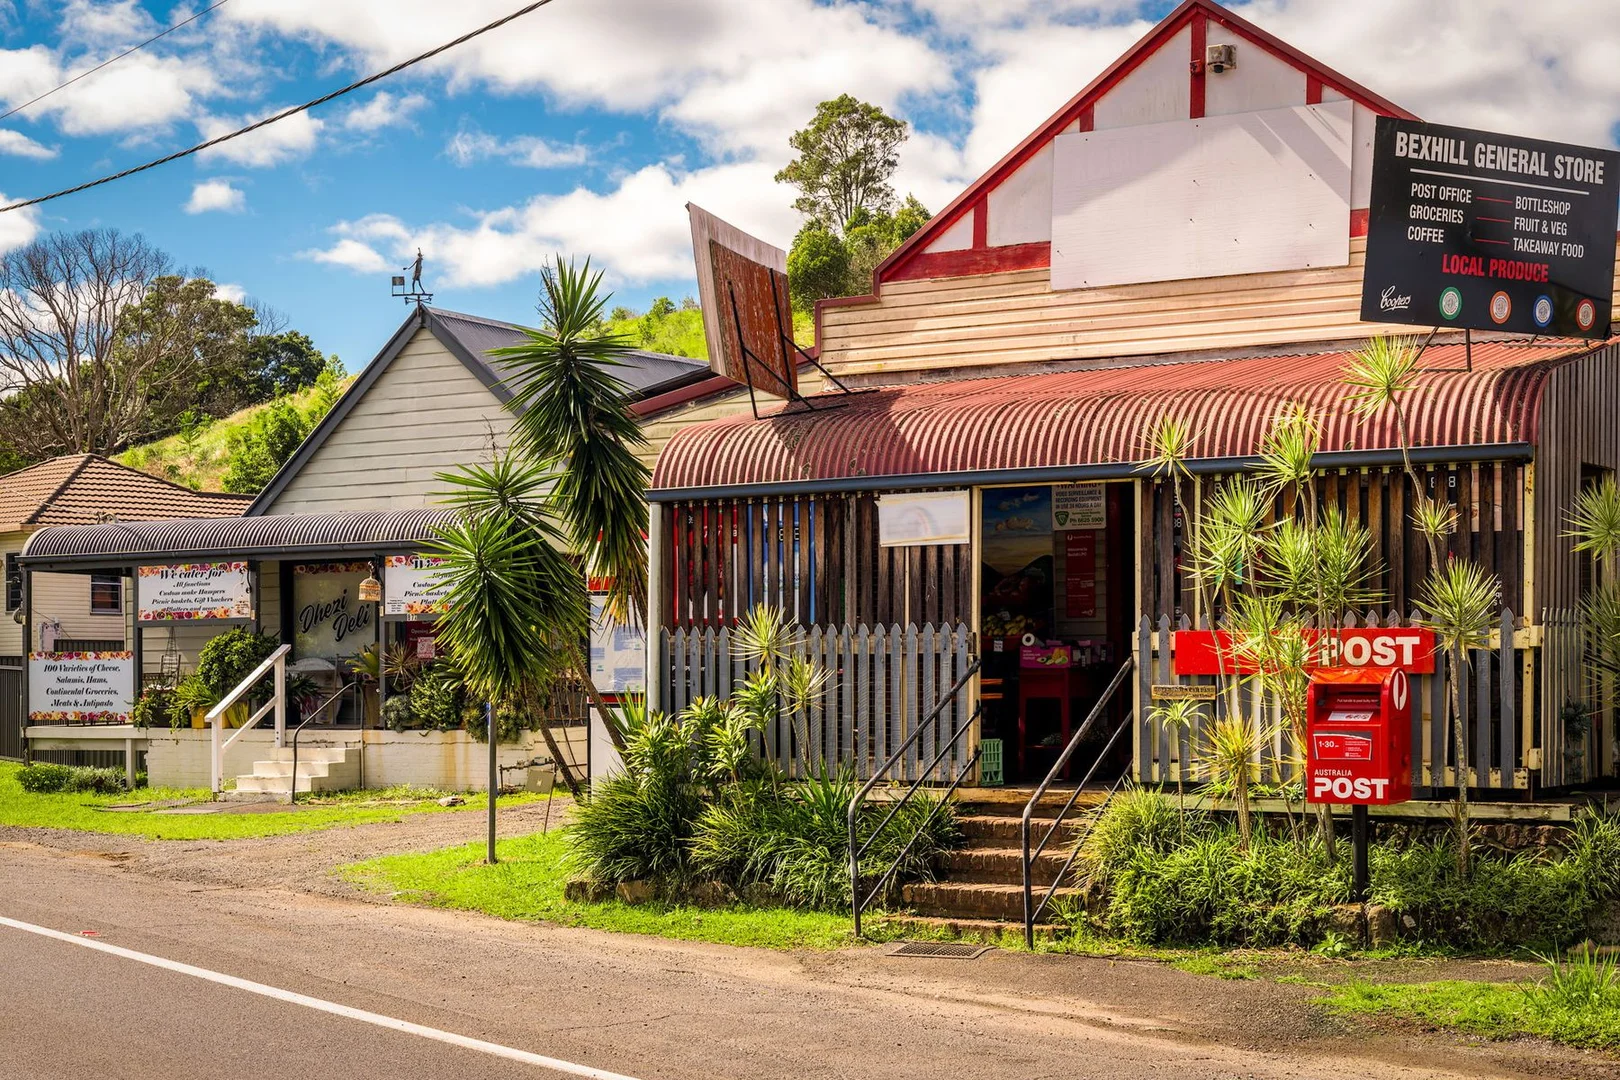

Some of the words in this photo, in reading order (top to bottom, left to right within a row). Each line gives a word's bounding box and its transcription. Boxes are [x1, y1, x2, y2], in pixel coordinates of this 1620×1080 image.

[1395, 132, 1468, 166] BEXHILL
[1474, 142, 1549, 176] GENERAL
[1553, 154, 1605, 184] STORE
[1411, 182, 1437, 198] POST
[1439, 186, 1472, 204] OFFICE
[1409, 204, 1464, 224] GROCERIES
[1515, 196, 1571, 216] BOTTLESHOP
[1408, 226, 1444, 243] COFFEE
[1514, 217, 1540, 234] FRUIT
[1542, 221, 1548, 234] &
[1550, 222, 1568, 236] VEG
[1513, 238, 1560, 256] TAKEAWAY
[1561, 243, 1584, 258] FOOD
[1442, 254, 1485, 276] LOCAL
[1488, 258, 1549, 283] PRODUCE
[1380, 286, 1412, 310] Coopers
[160, 569, 178, 580] We
[179, 570, 206, 579] cater
[206, 568, 225, 580] for
[299, 588, 348, 634] Dhezi
[332, 604, 370, 642] Deli
[1322, 636, 1420, 666] POST
[59, 664, 88, 672] Varieties
[89, 664, 97, 673] of
[85, 687, 119, 695] Groceries,
[80, 699, 113, 708] Antipasto
[1314, 777, 1389, 799] POST
